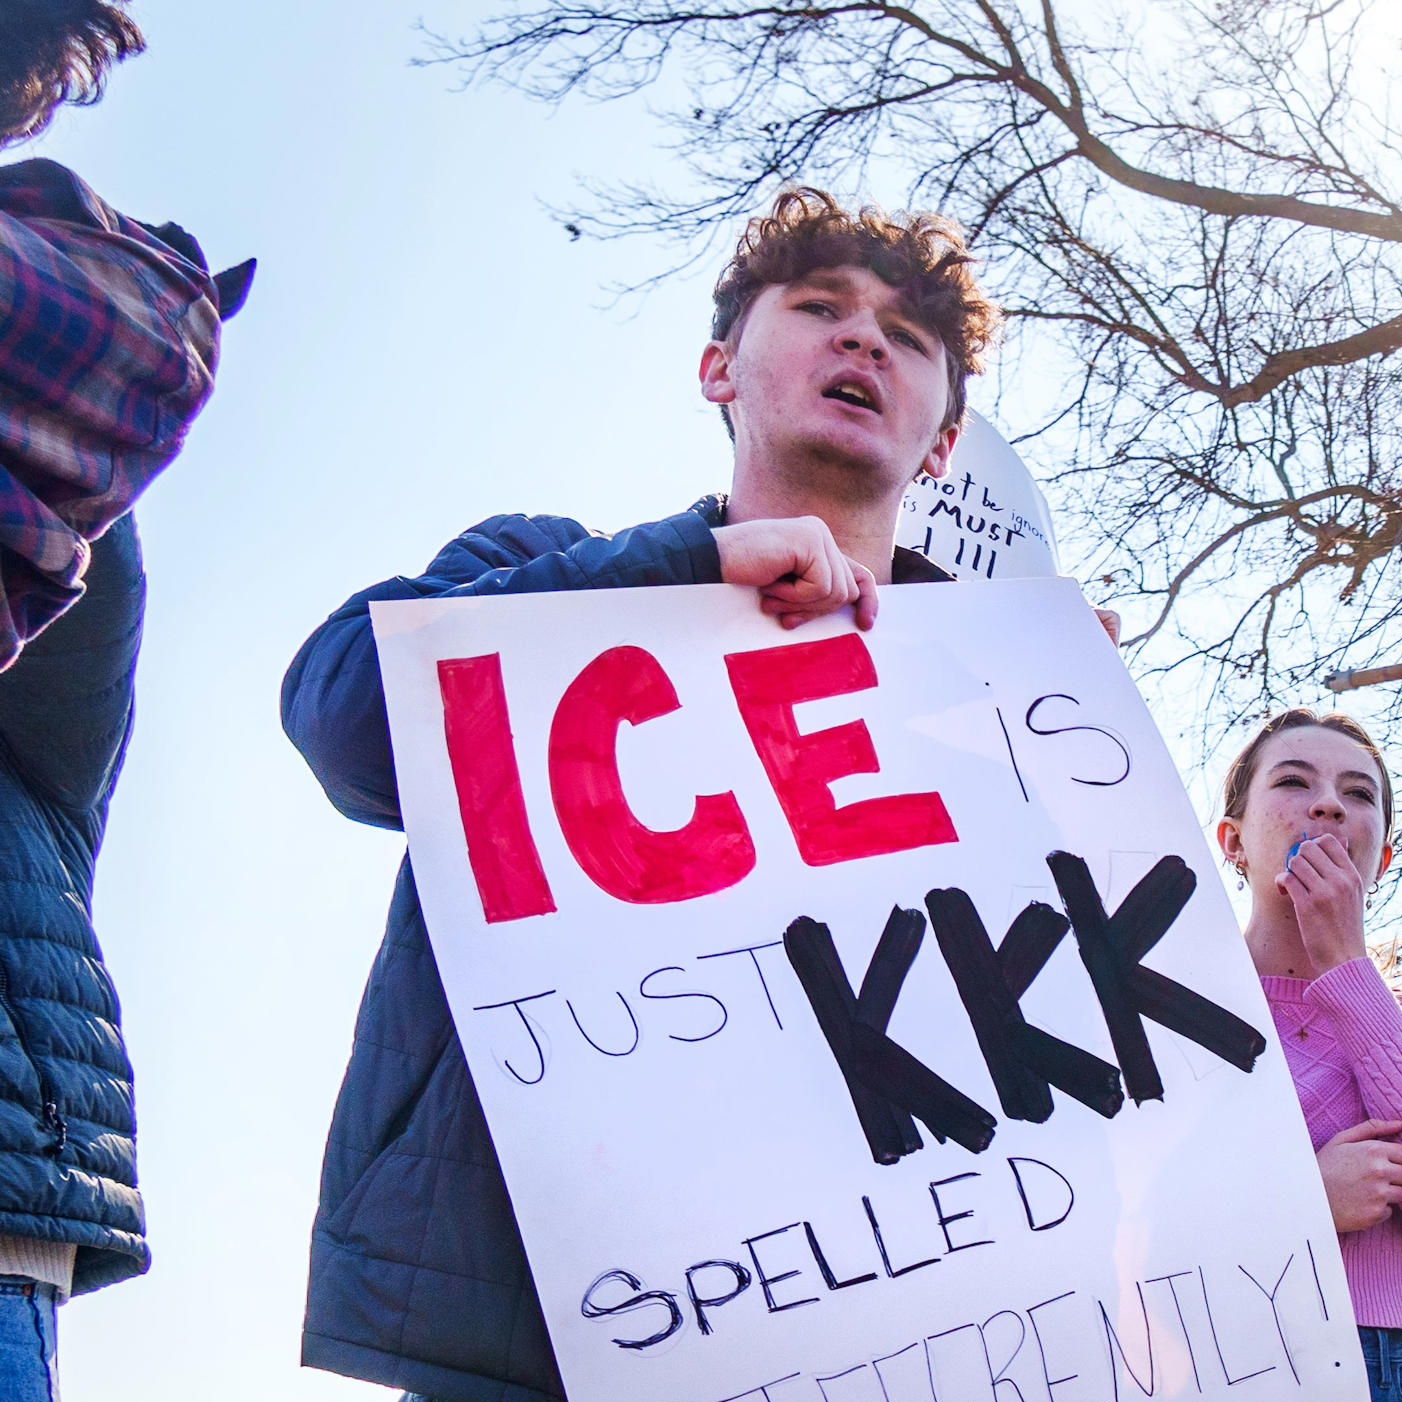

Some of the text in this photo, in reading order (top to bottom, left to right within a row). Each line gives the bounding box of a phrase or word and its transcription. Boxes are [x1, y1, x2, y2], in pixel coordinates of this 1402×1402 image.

[928, 499, 1026, 546] MUST
[982, 487, 1004, 511] be
[437, 632, 959, 924] ICE
[474, 850, 1267, 1165] JUST KKK
[581, 1156, 1075, 1350] SPELLED
